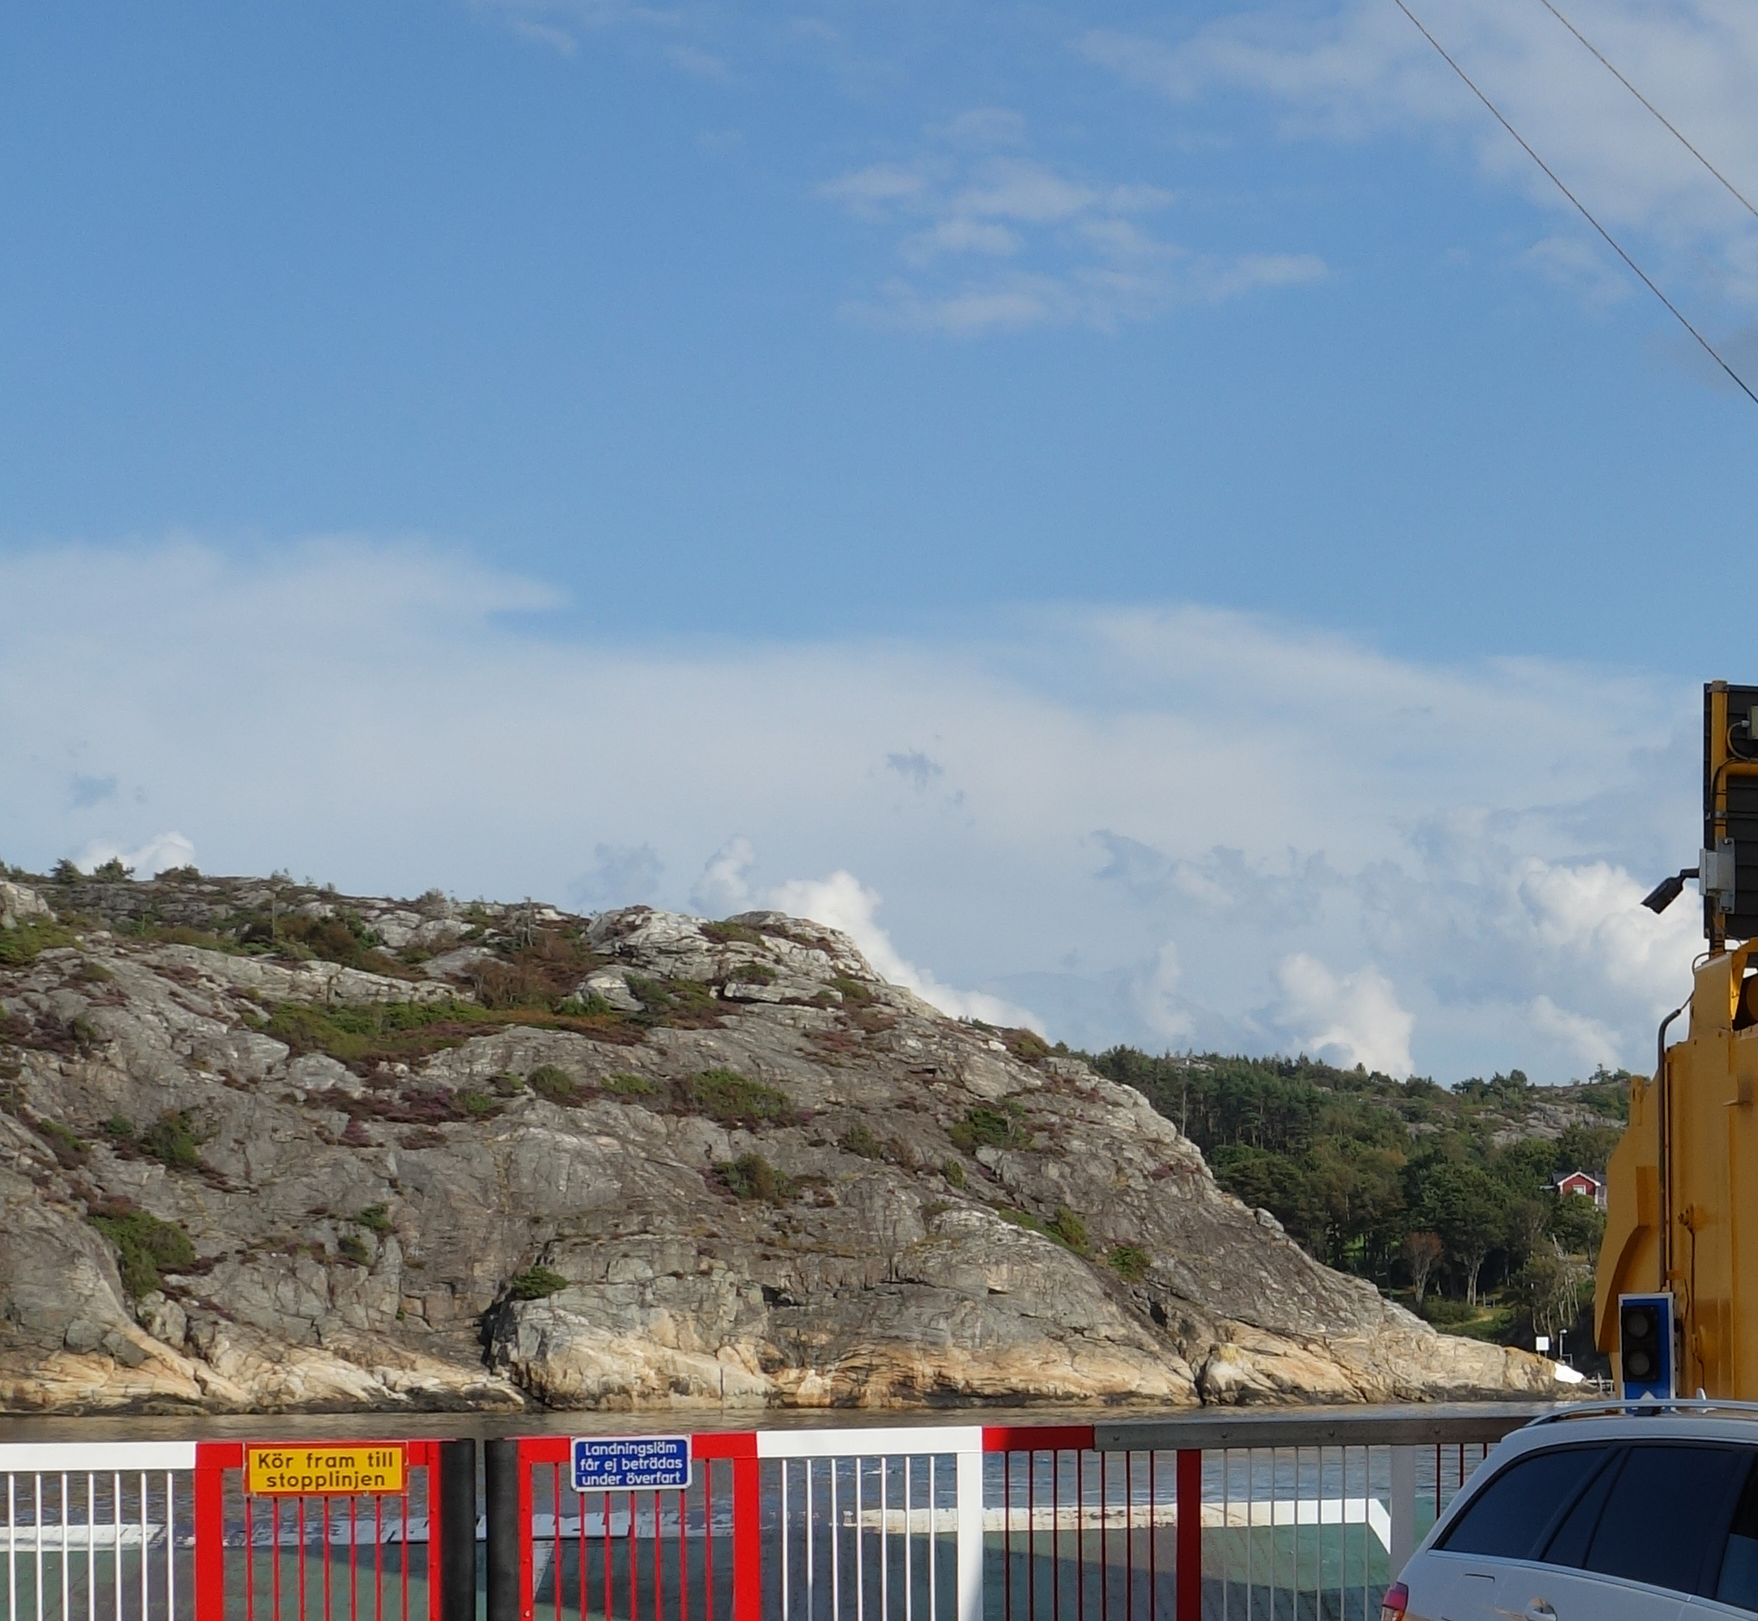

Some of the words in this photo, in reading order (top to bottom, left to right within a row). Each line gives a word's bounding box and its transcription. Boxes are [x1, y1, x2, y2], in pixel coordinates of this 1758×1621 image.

[584, 1441, 677, 1457] Landningsläm
[258, 1453, 294, 1469] Kör
[306, 1452, 355, 1468] fram
[367, 1451, 393, 1467] till
[580, 1458, 600, 1471] får
[604, 1458, 617, 1473] ej
[621, 1457, 683, 1470] beträdas
[266, 1471, 385, 1490] stopplinjen
[582, 1473, 622, 1485] under
[626, 1471, 681, 1484] överfart
